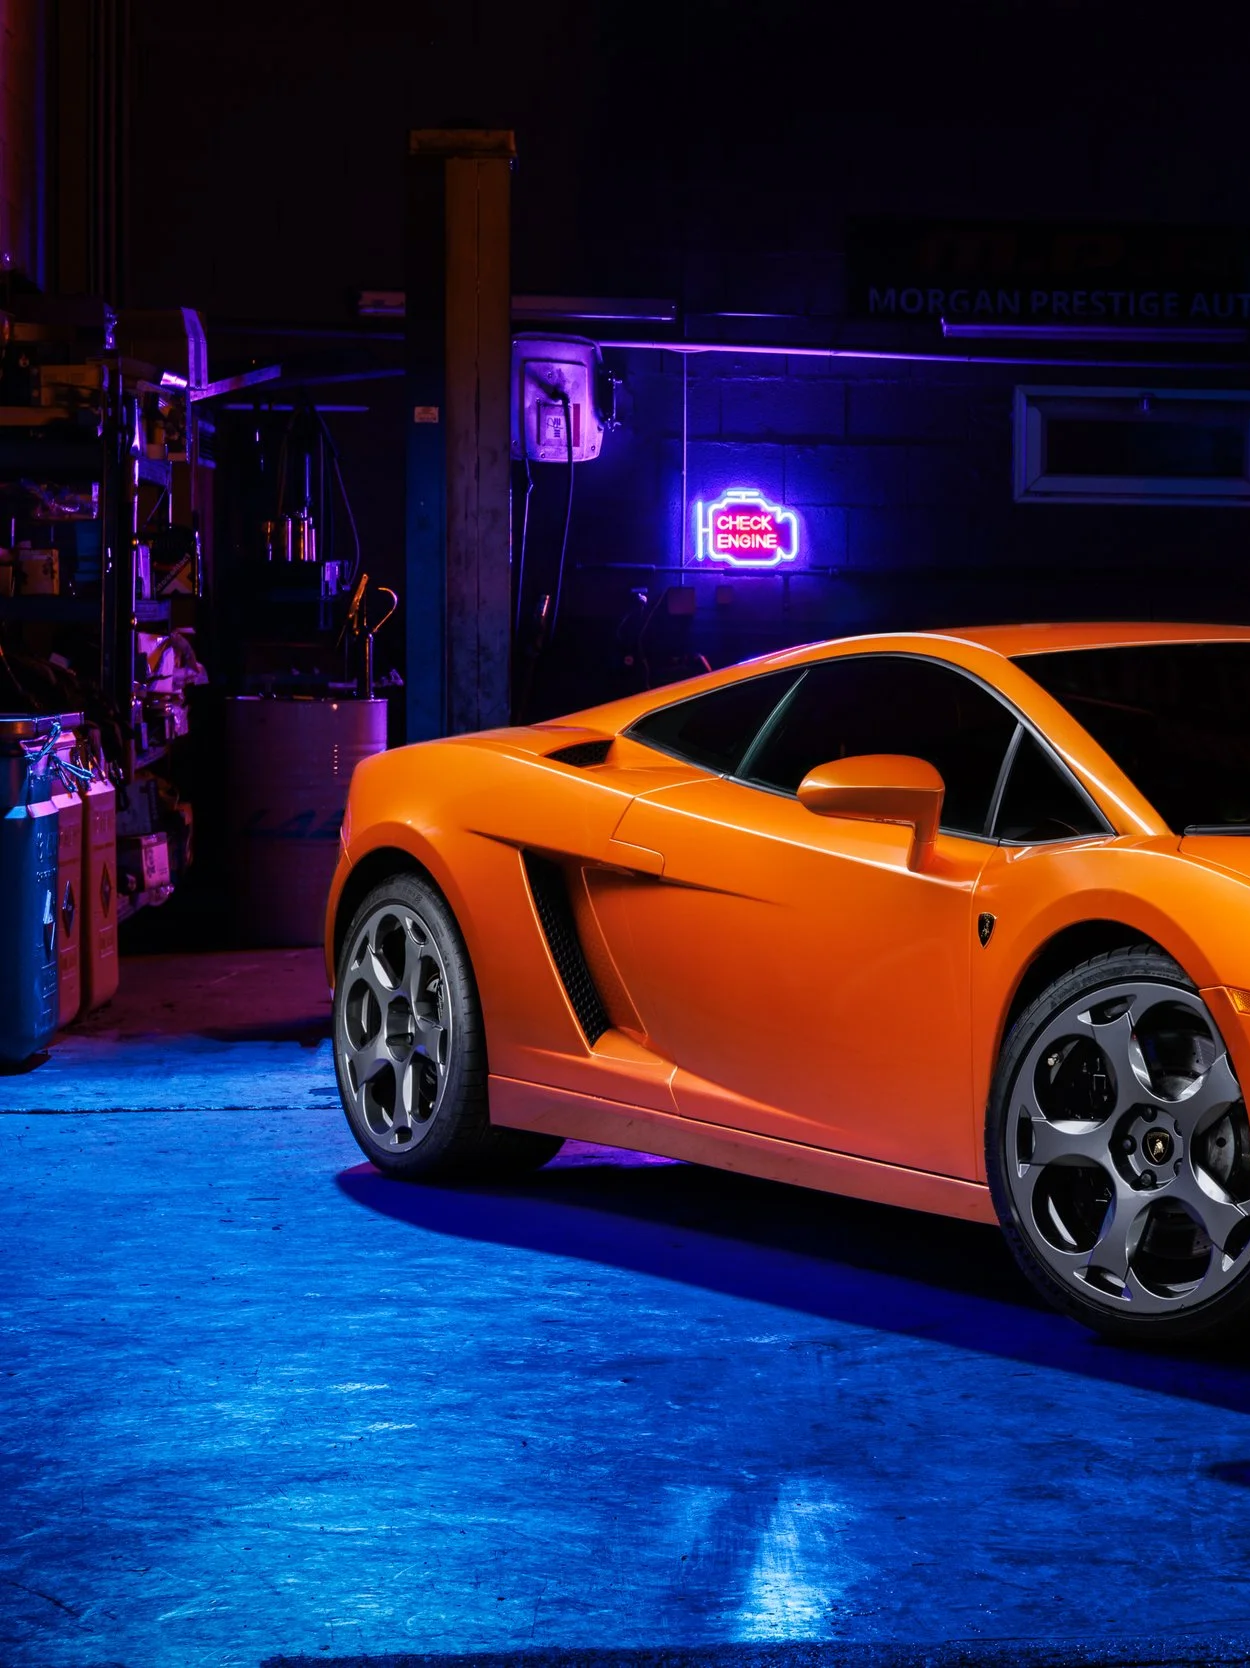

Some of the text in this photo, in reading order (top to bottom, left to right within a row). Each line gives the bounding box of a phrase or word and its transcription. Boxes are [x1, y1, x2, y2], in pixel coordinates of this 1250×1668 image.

[868, 285, 1019, 315] MORGAN
[1031, 290, 1179, 318] PRESTIGE
[717, 515, 772, 531] CHECK
[717, 533, 777, 549] ENGINE
